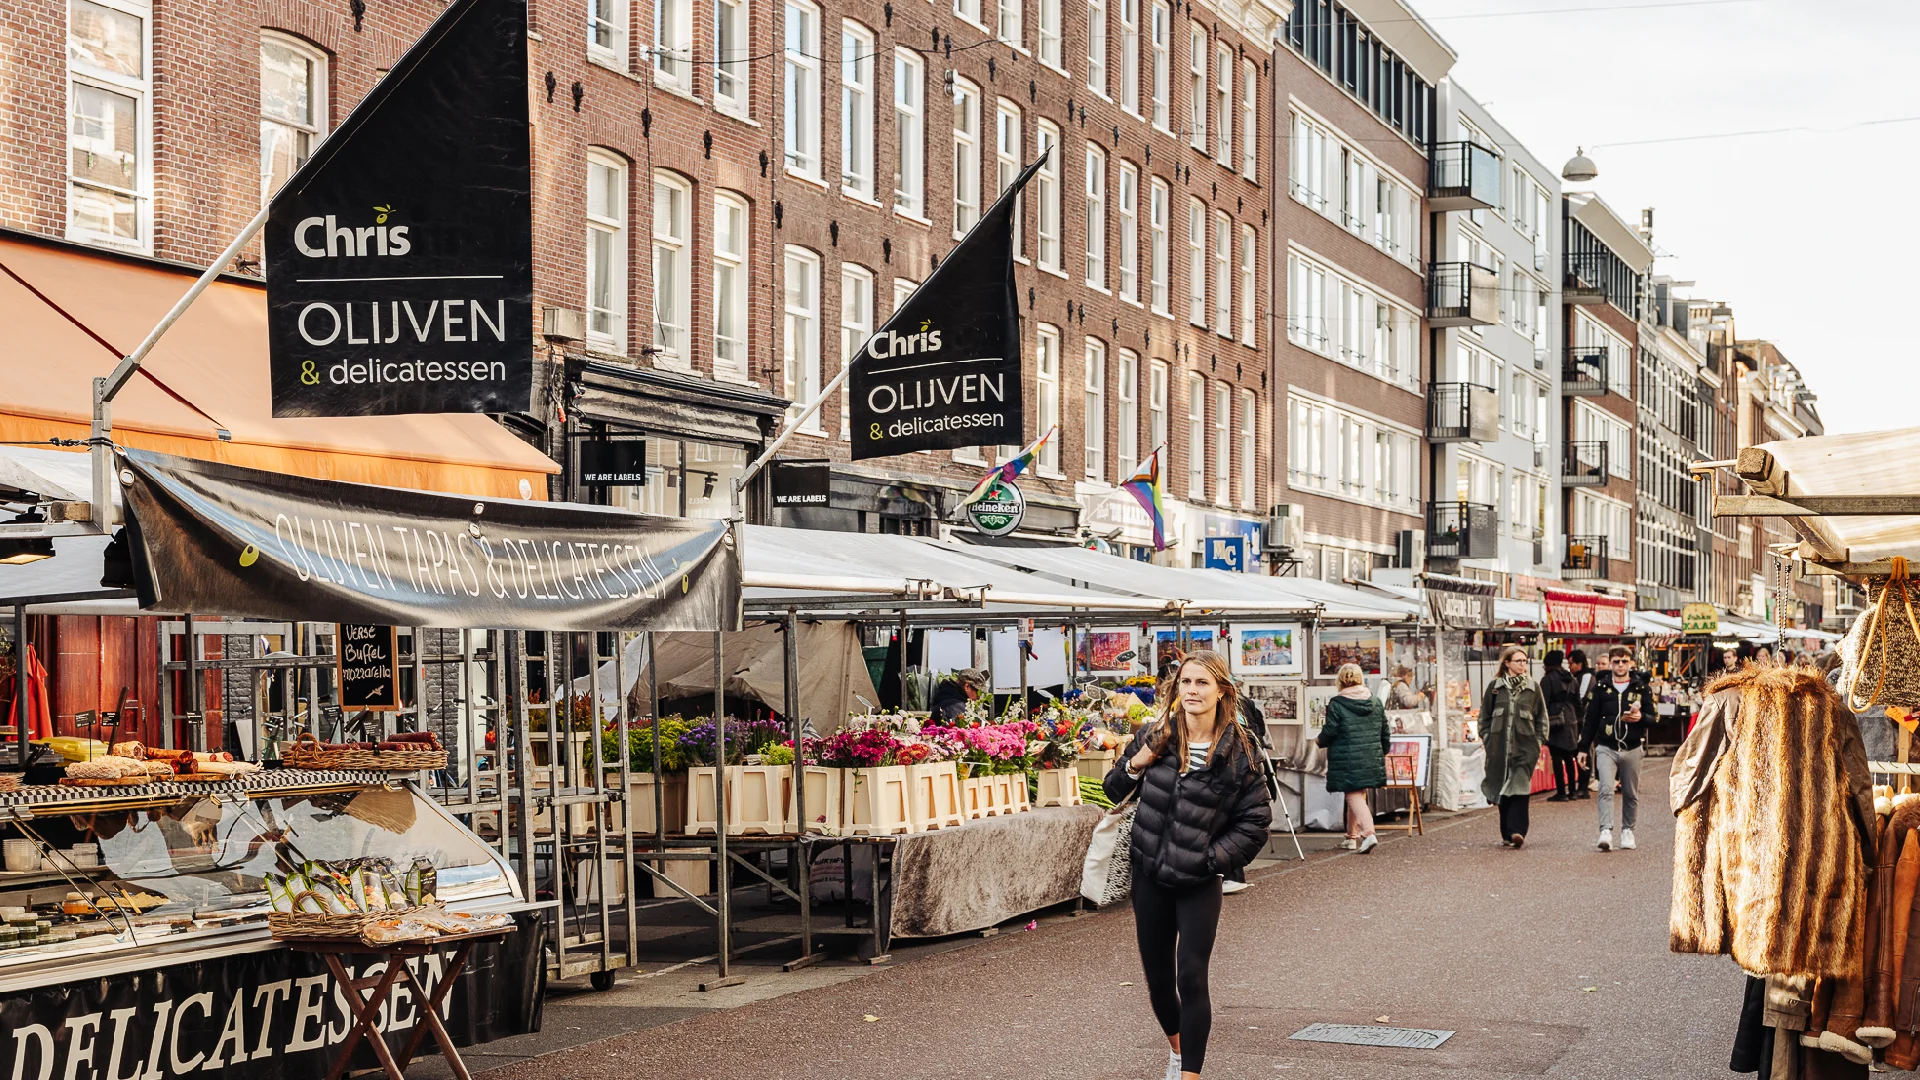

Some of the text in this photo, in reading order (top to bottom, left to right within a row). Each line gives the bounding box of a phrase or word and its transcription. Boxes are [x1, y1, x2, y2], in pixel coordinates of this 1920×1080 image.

[294, 213, 411, 258] Chris
[298, 299, 505, 346] OLIJVEN
[867, 329, 942, 359] Chris
[300, 358, 506, 385] & delicatessen
[868, 373, 1004, 413] OLIJVEN
[869, 413, 1004, 440] & delicatessen
[584, 473, 641, 481] WE ARE LABELS
[777, 494, 827, 503] WE ARE LABELS
[971, 502, 1019, 513] Heineken
[275, 513, 666, 600] OLIJVEN TAPAS & DELICATESSEN
[1683, 621, 1716, 630] KAAS
